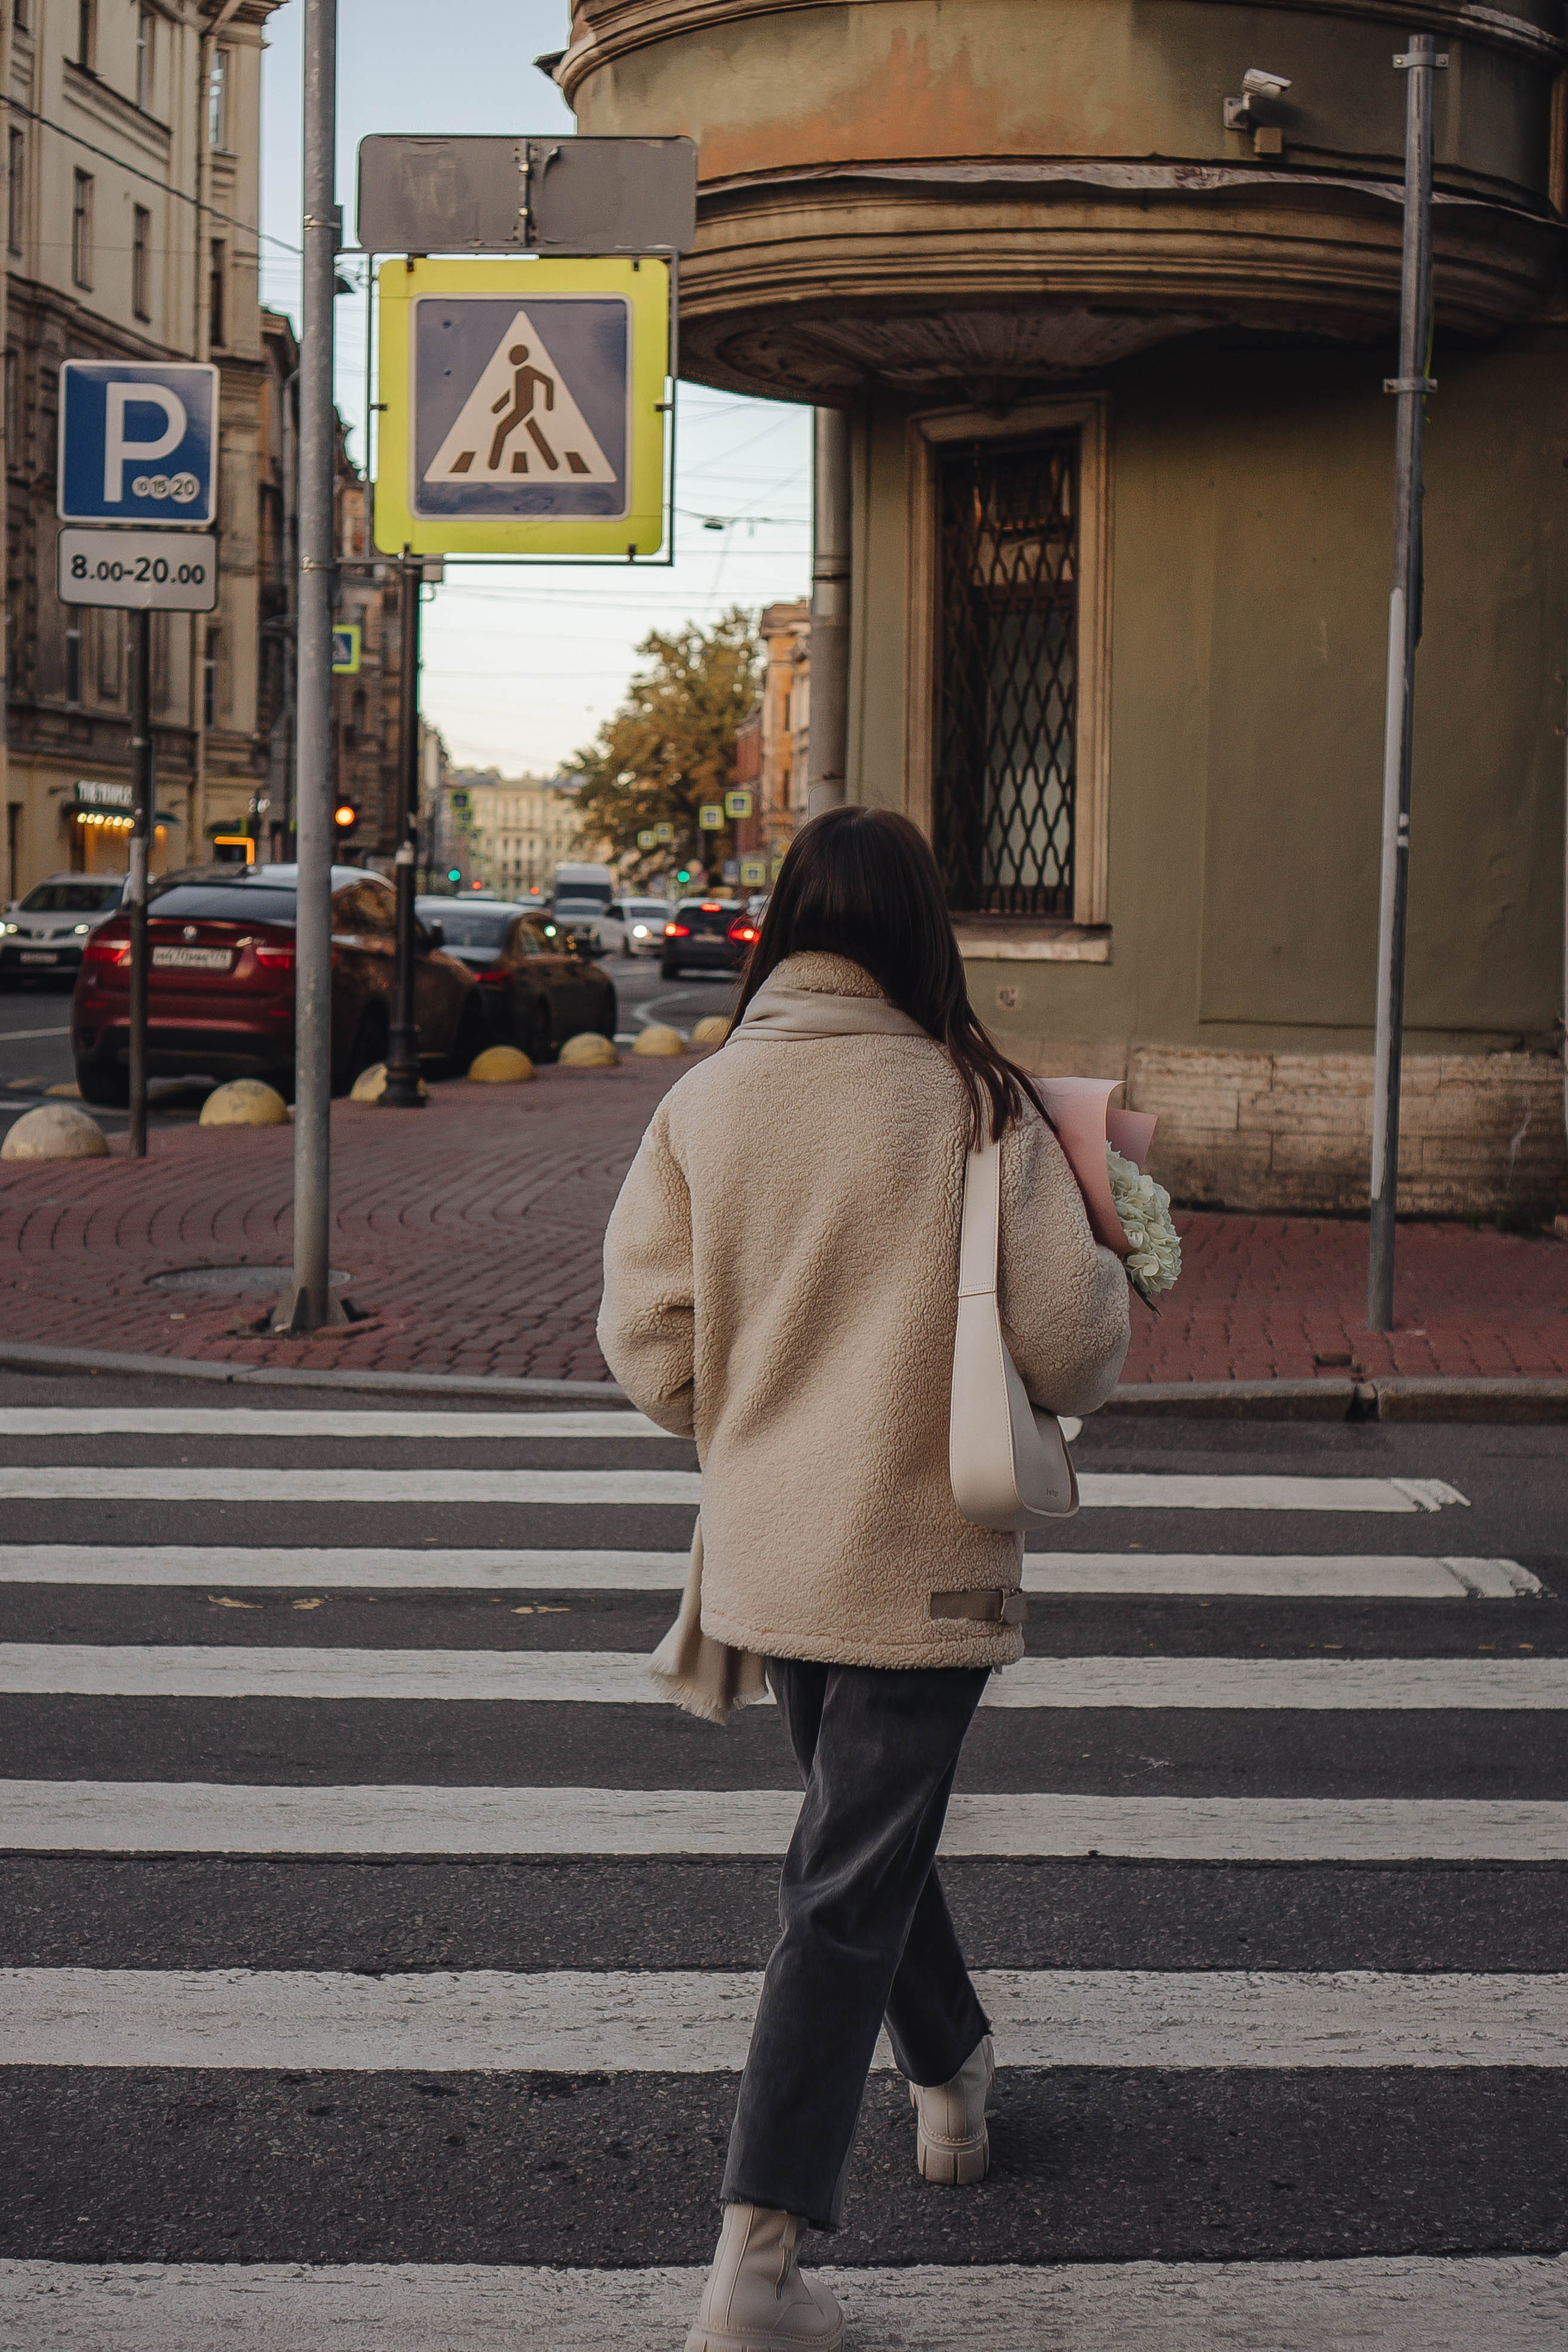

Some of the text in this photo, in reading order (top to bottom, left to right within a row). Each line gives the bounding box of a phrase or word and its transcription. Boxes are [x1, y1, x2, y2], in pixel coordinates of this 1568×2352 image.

[104, 382, 186, 502] P
[136, 479, 195, 496] 10 15 20
[71, 554, 205, 584] 8.00-20.00
